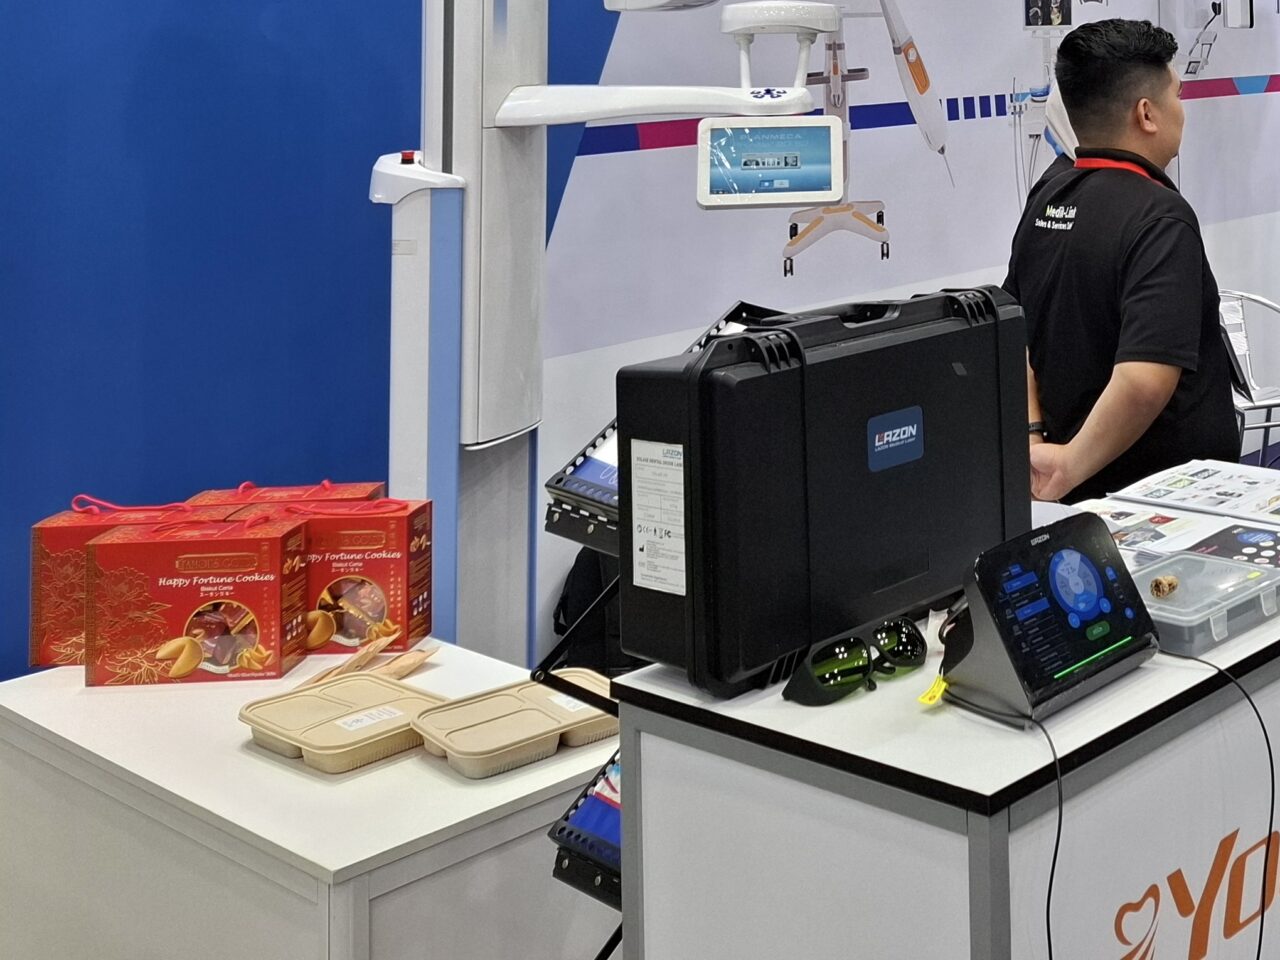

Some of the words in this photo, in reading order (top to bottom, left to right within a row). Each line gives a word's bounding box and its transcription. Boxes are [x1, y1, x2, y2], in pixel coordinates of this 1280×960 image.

[875, 424, 917, 447] LAZON
[307, 554, 323, 563] ppy
[325, 552, 363, 561] Fortune
[364, 550, 401, 559] Cookies
[158, 577, 191, 588] Happy
[193, 576, 235, 586] Fortune
[235, 572, 275, 582] Cookies
